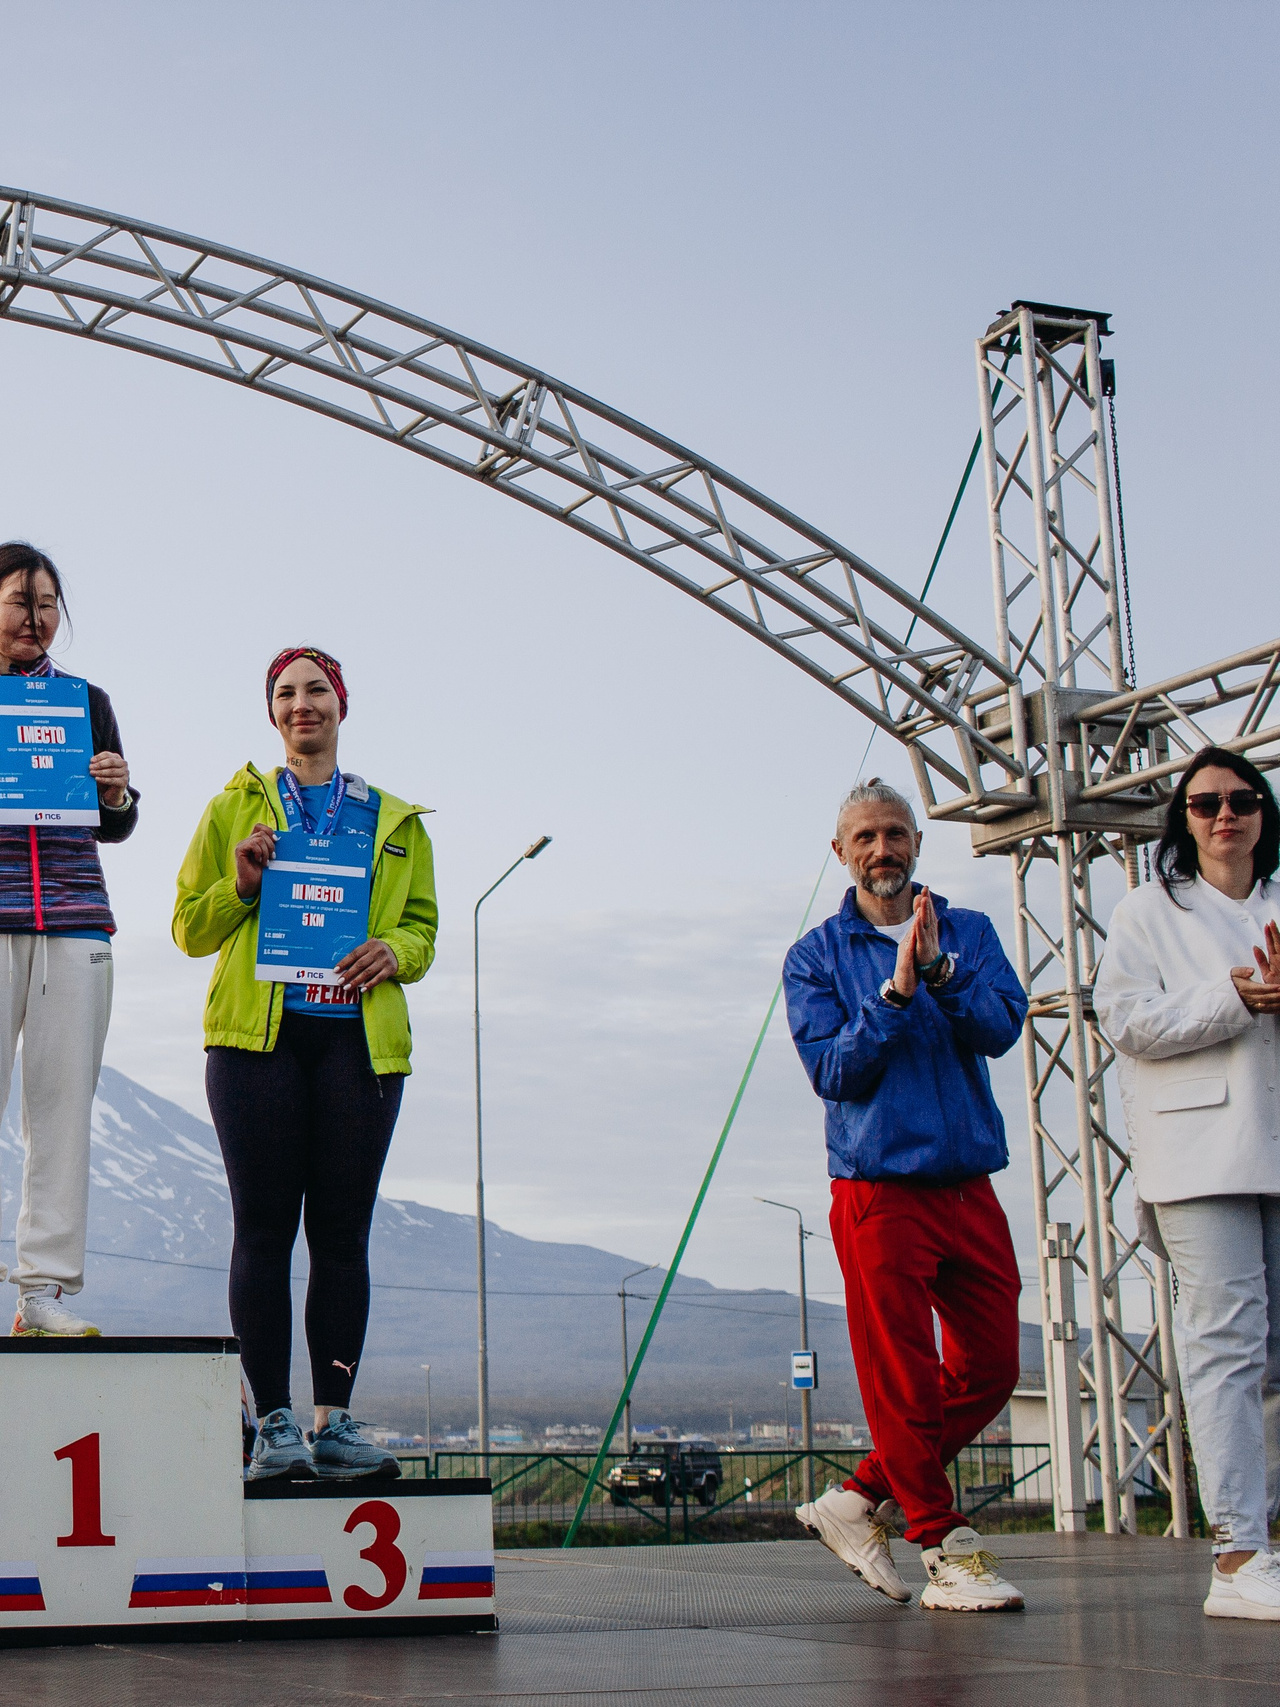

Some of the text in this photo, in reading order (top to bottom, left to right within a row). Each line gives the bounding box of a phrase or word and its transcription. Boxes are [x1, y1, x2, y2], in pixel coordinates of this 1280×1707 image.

[24, 726, 66, 744] МЕСТО
[31, 756, 54, 769] 5 КМ
[304, 885, 344, 903] МЕСТО
[302, 912, 325, 928] 5 КМ
[53, 1431, 117, 1548] 1
[342, 1499, 408, 1612] 3
